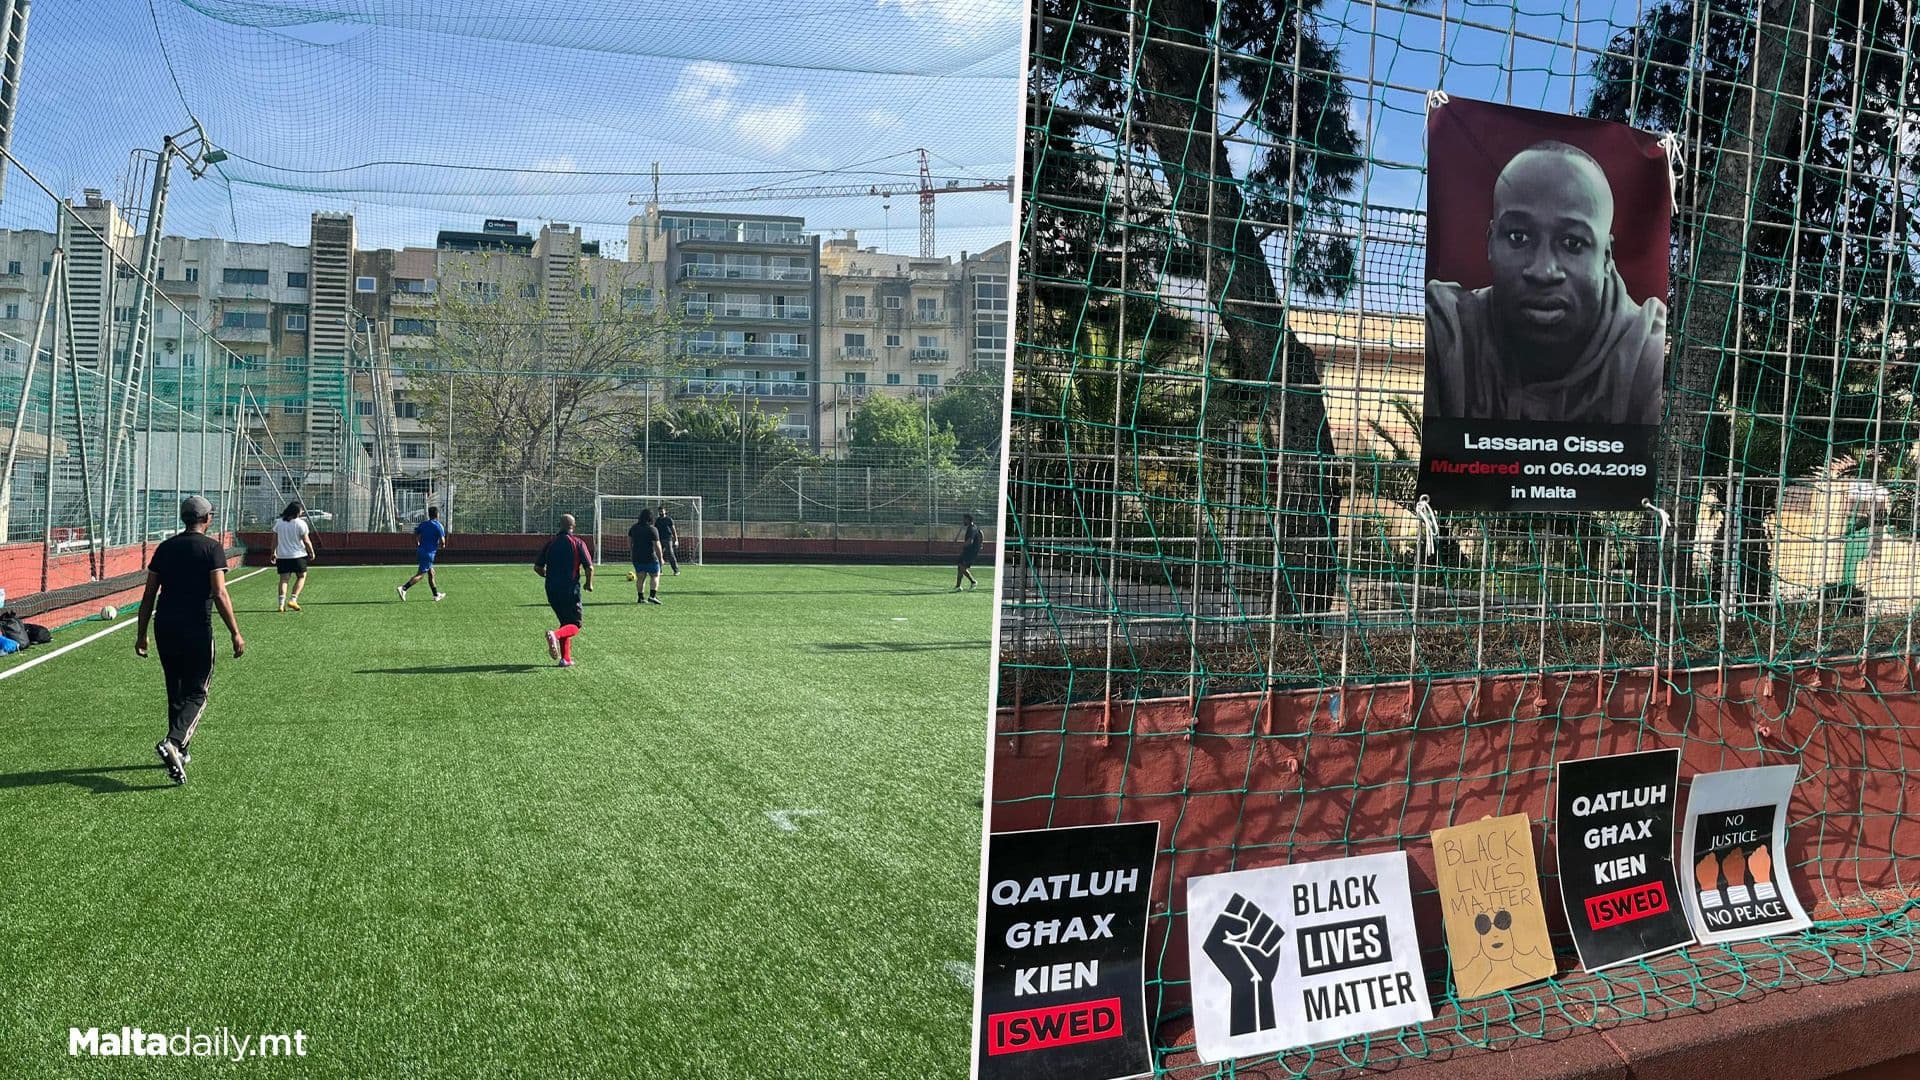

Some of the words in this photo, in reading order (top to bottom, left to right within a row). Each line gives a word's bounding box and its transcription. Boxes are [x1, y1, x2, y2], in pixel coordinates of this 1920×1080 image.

[1464, 433, 1558, 452] Lassana
[1564, 437, 1624, 453] Cisse
[1431, 460, 1520, 475] Murdered
[1523, 464, 1546, 476] on
[1549, 463, 1647, 477] 06.04.2019
[1511, 486, 1526, 499] in
[1530, 486, 1577, 499] Malta
[1571, 784, 1667, 817] QATLUH
[1725, 814, 1744, 828] NO
[1443, 830, 1524, 867] BLACK
[1709, 830, 1758, 851] JUSTICE
[1455, 863, 1526, 893] LIVES
[1594, 853, 1647, 885] KIEN
[991, 868, 1139, 906] QATLUH
[1293, 874, 1381, 916] BLACK
[1450, 887, 1534, 917] MATTER
[1591, 888, 1663, 924] ISWED
[1706, 908, 1733, 927] NO
[1734, 901, 1786, 922] PEACE
[1304, 923, 1382, 969] LIVES
[1014, 959, 1099, 997] KIEN
[1303, 971, 1417, 1022] MATTER
[996, 1007, 1115, 1048] ISWED
